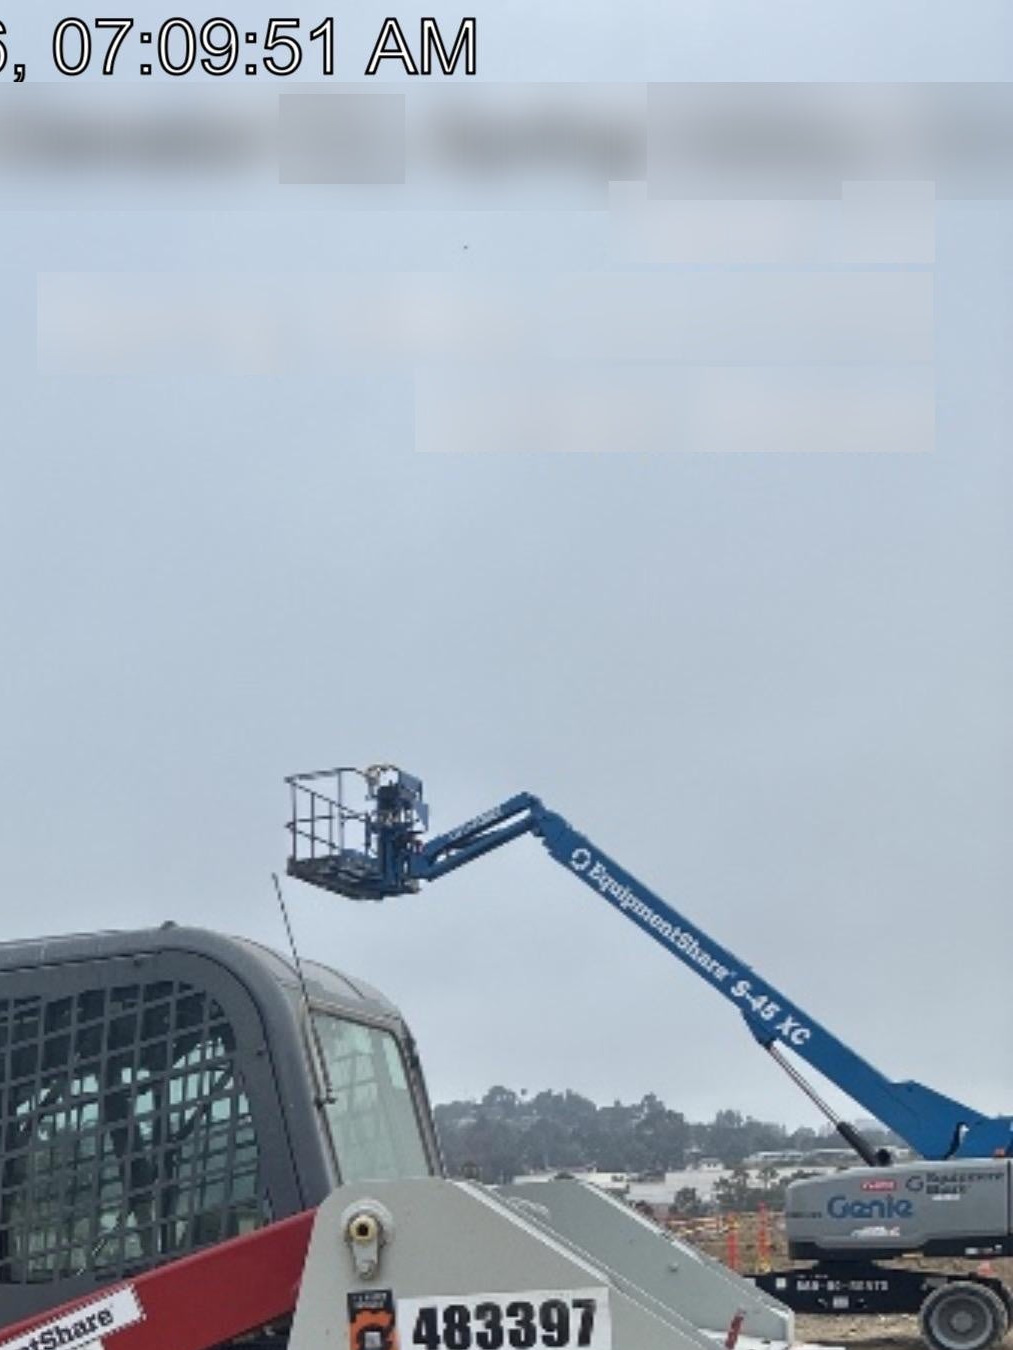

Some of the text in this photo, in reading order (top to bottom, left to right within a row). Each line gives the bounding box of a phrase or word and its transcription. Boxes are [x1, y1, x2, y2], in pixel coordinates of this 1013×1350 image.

[731, 979, 780, 1021] S-45
[775, 1015, 811, 1045] XC
[827, 1195, 913, 1219] Genie
